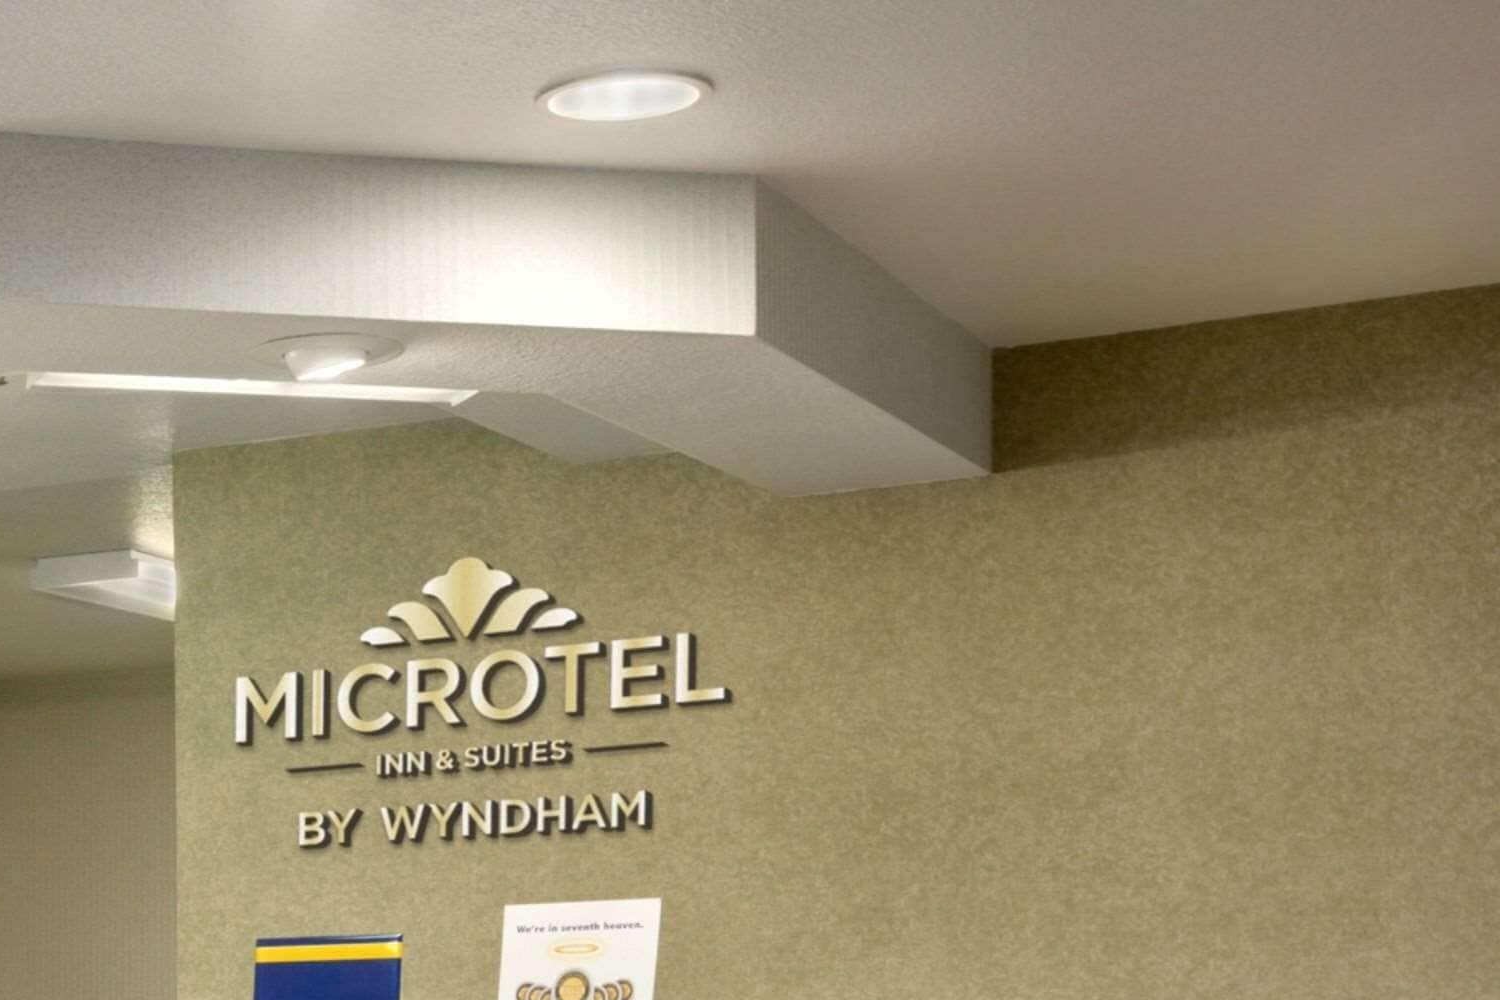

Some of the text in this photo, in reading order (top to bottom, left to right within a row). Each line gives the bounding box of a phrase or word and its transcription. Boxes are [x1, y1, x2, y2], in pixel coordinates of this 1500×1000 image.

[234, 631, 731, 745] MICROTEL
[376, 738, 574, 778] INN & SUITES
[299, 787, 653, 848] BY WYNDHAM
[516, 921, 645, 934] We're in seventh heaven.
